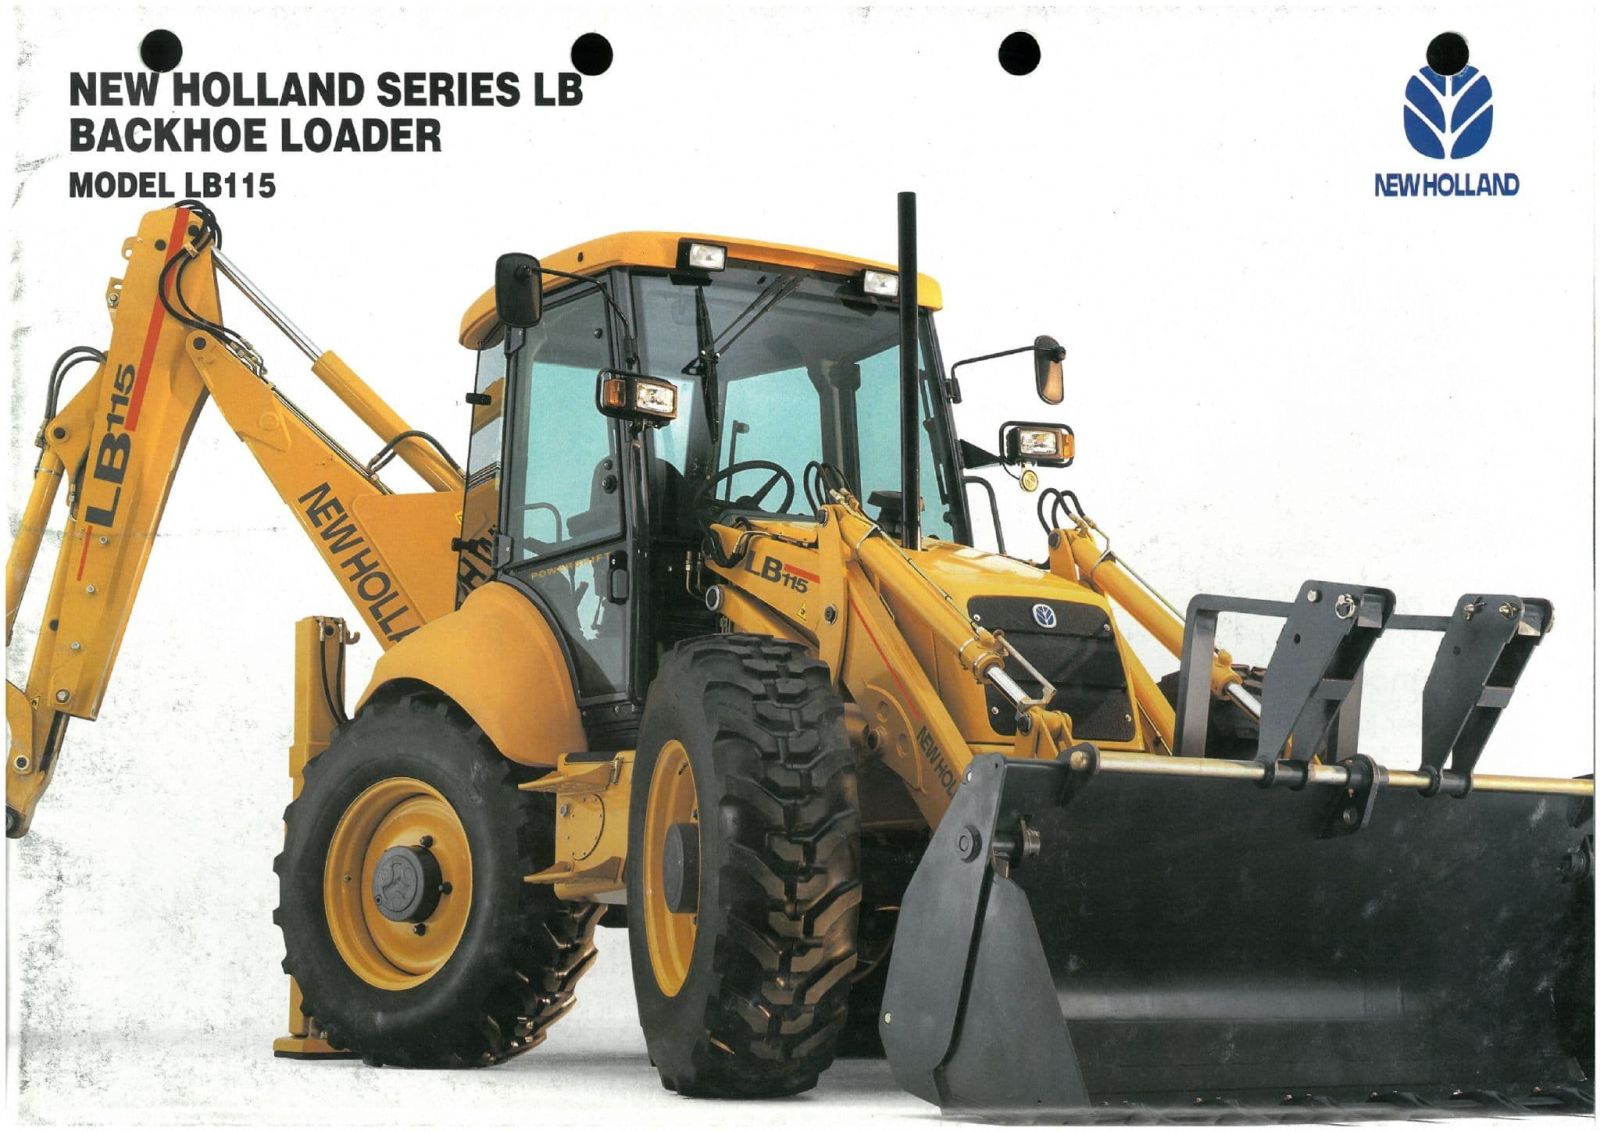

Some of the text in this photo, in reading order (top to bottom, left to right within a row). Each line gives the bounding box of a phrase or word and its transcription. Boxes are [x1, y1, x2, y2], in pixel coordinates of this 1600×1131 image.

[70, 71, 584, 108] NEW HOLLAND SERIES LB
[70, 117, 442, 153] BACKHOE LOADER
[69, 171, 276, 199] MODEL LB115
[1375, 172, 1520, 197] NEW HOLLAND
[84, 363, 136, 528] LB115
[298, 481, 364, 554] NEW
[744, 550, 809, 594] LB115
[916, 725, 942, 764] NEW
